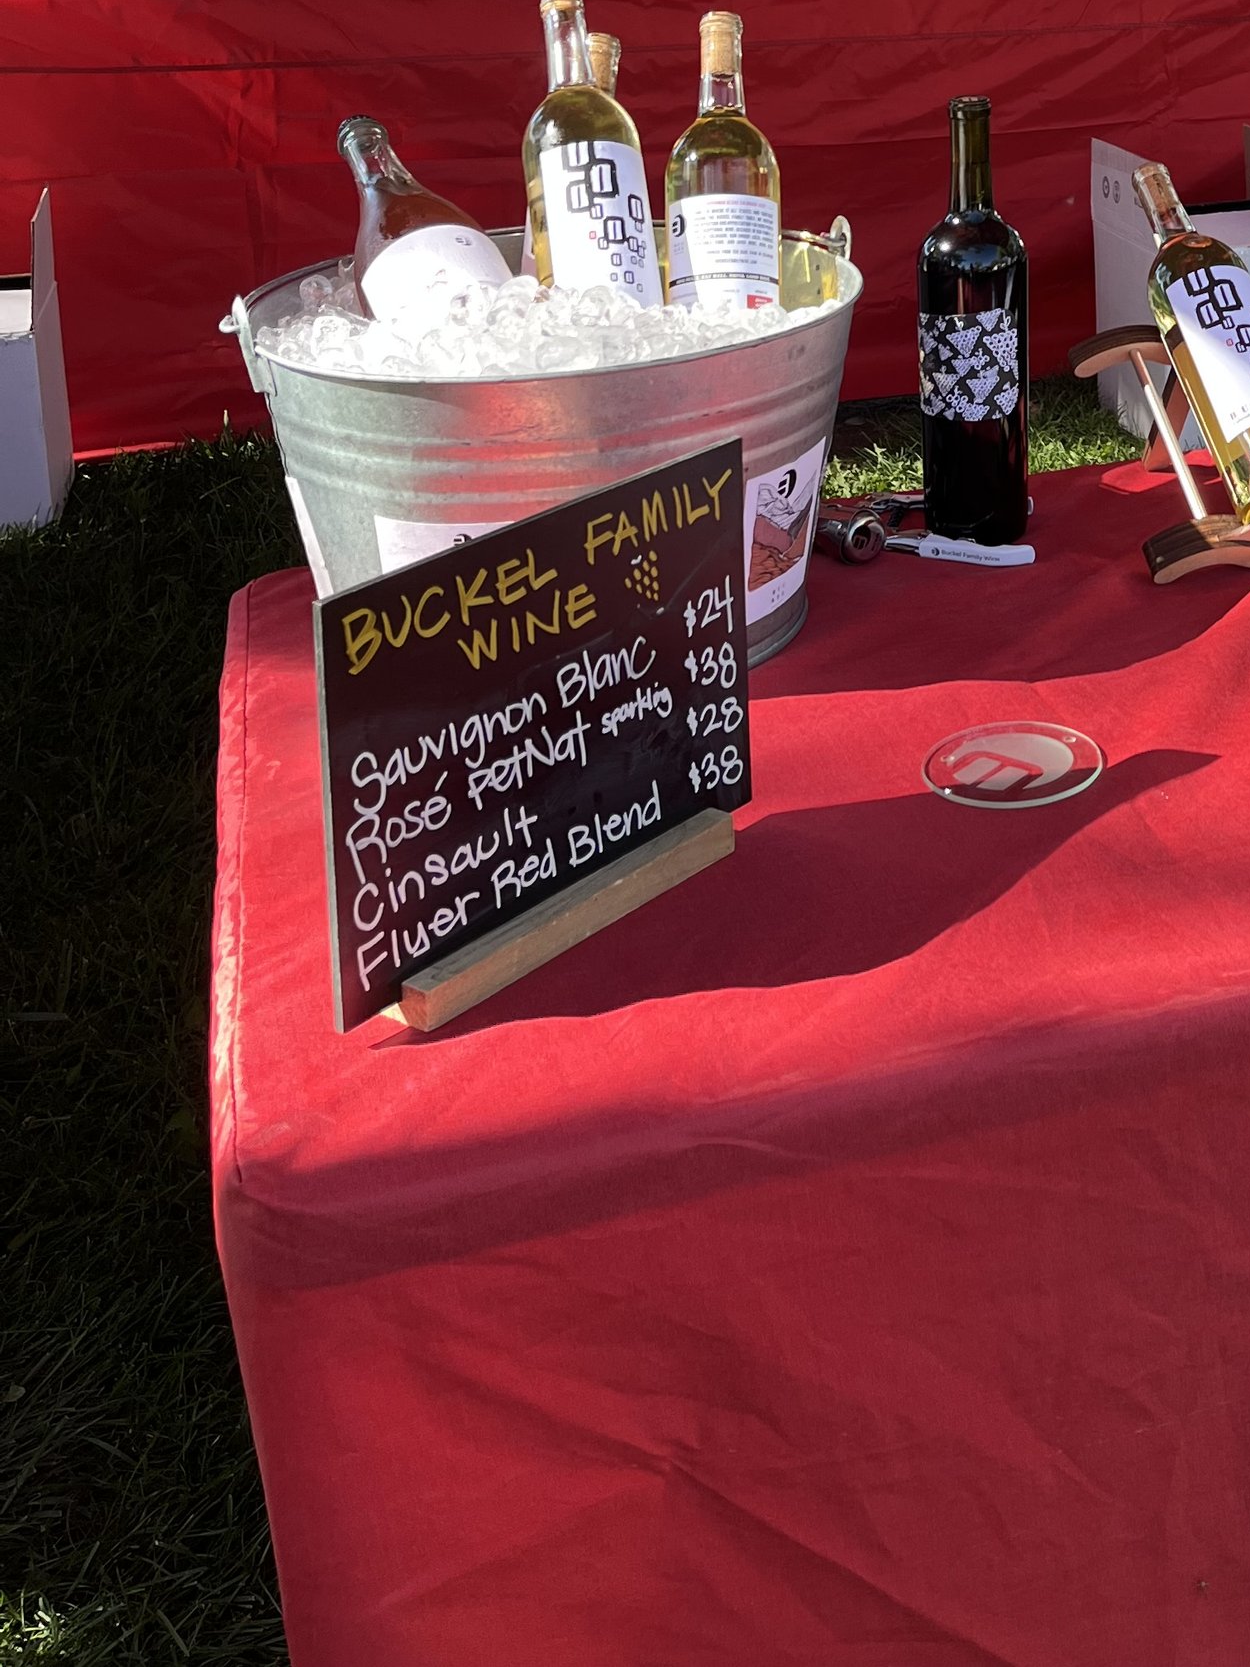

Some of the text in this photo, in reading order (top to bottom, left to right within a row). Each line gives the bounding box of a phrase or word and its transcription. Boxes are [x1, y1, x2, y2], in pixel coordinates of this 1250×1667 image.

[342, 469, 732, 674] BUCKEL FAMILY
[457, 583, 597, 670] WINE
[684, 641, 738, 689] $38
[351, 692, 546, 815] Sauvignon
[684, 575, 735, 637] $24
[353, 696, 744, 932] Cinsault $28
[356, 745, 744, 992] Flyer Red Blend $38
